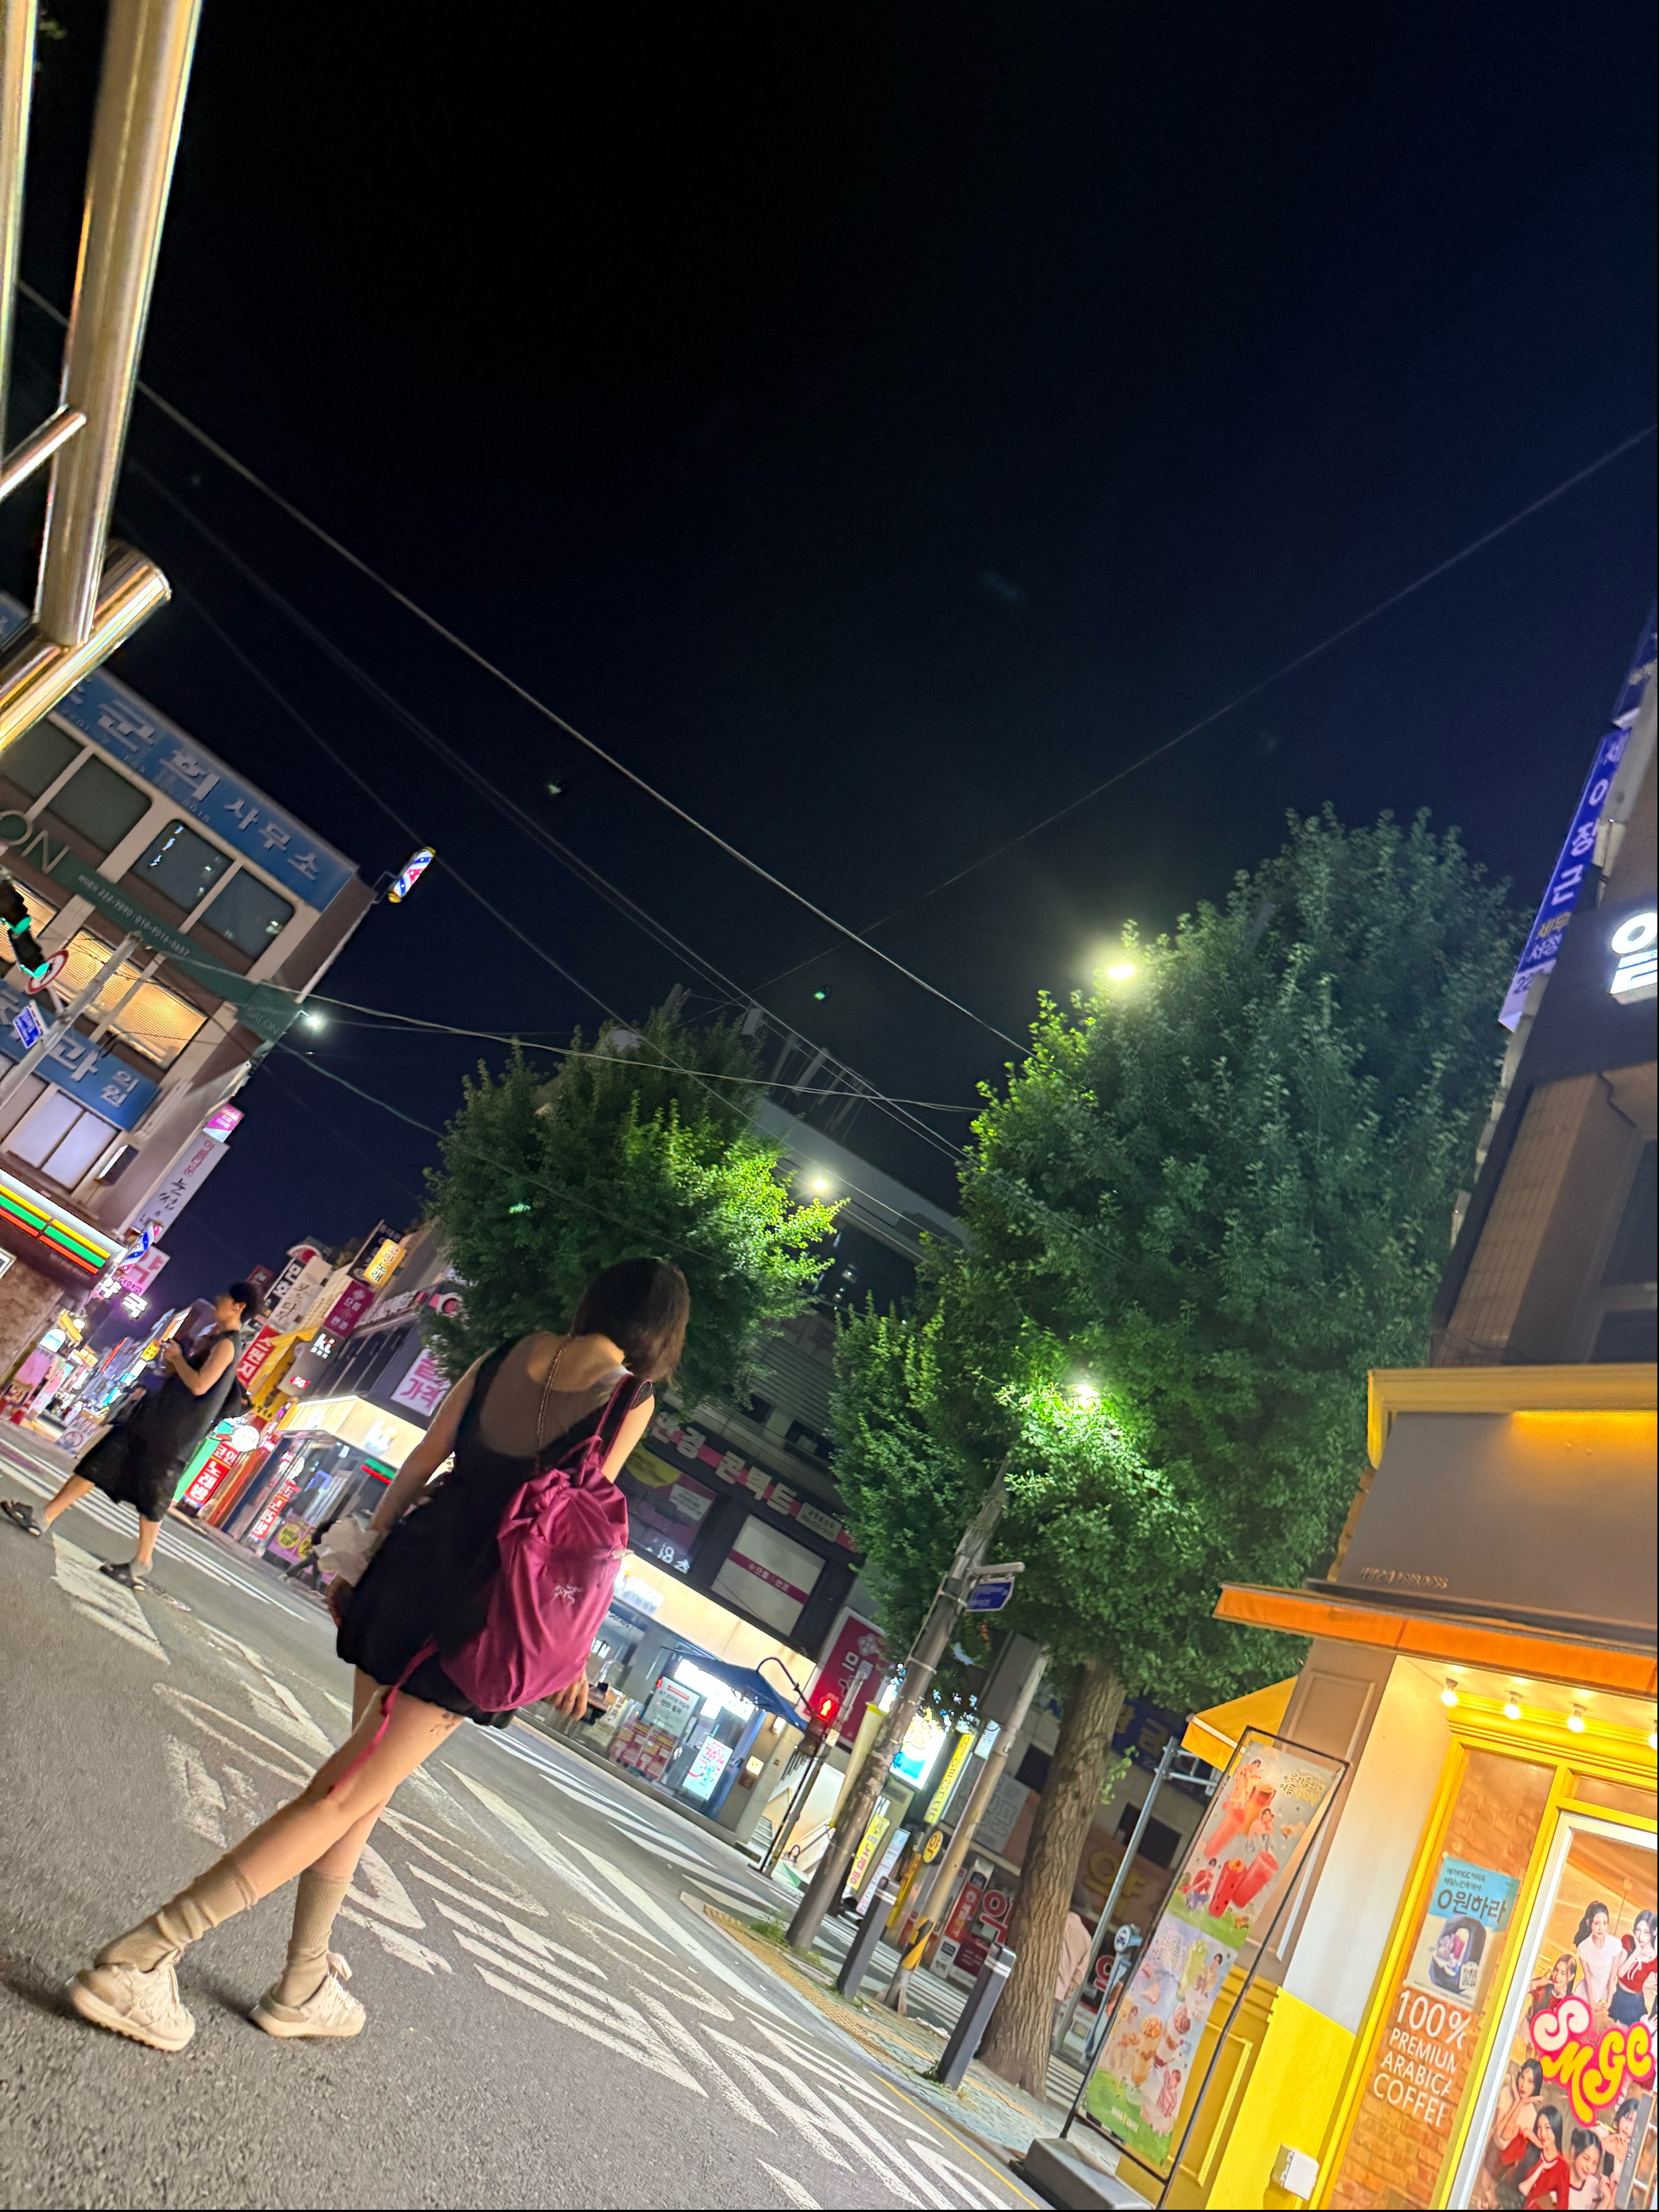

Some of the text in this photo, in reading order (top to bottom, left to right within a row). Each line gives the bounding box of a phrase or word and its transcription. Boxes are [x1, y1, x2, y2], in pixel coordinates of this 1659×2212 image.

[224, 799, 320, 882] 사무소
[101, 1070, 139, 1108] 의원
[159, 1178, 187, 1211] 눈썹
[370, 1245, 401, 1283] 코인노래
[99, 1278, 149, 1319] 약국
[292, 1376, 307, 1389] 5G
[211, 1445, 239, 1466] 코인
[190, 1462, 222, 1502] 노래방
[927, 1835, 943, 1861] 약
[1437, 1889, 1507, 1924] 0원하라
[1396, 1989, 1472, 2051] 100%
[1381, 2050, 1453, 2097] ARABICA
